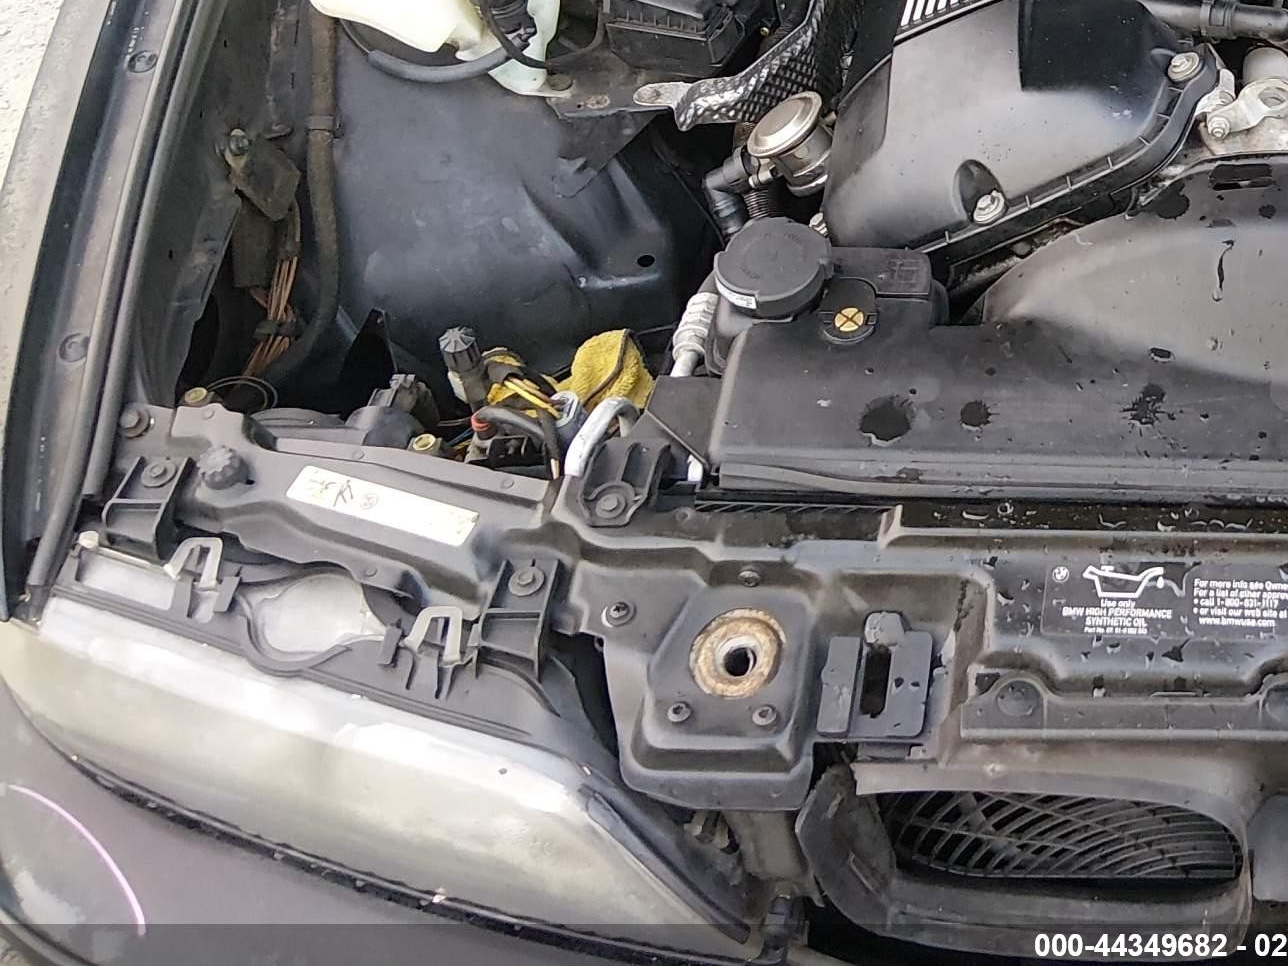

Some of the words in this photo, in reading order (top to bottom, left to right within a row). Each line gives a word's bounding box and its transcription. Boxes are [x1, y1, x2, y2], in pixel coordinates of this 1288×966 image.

[1194, 578, 1209, 587] For
[1209, 580, 1231, 588] more
[1232, 580, 1248, 589] info
[1193, 588, 1208, 597] For
[1216, 589, 1229, 597] list
[1229, 589, 1239, 597] of
[1240, 590, 1261, 598] other
[1100, 599, 1116, 608] Use
[1117, 599, 1136, 609] only
[1200, 598, 1215, 607] call
[1062, 606, 1084, 617] BMW
[1085, 607, 1107, 617] HIGH
[1108, 608, 1173, 619] PERFORMANCE
[1210, 607, 1227, 616] visit
[1244, 608, 1261, 617] web
[1262, 609, 1278, 618] site
[1279, 610, 1288, 618] at
[1085, 617, 1132, 627] SYNTHETIC
[1132, 618, 1148, 627] OIL
[1199, 617, 1276, 627] www.bmwusa.com
